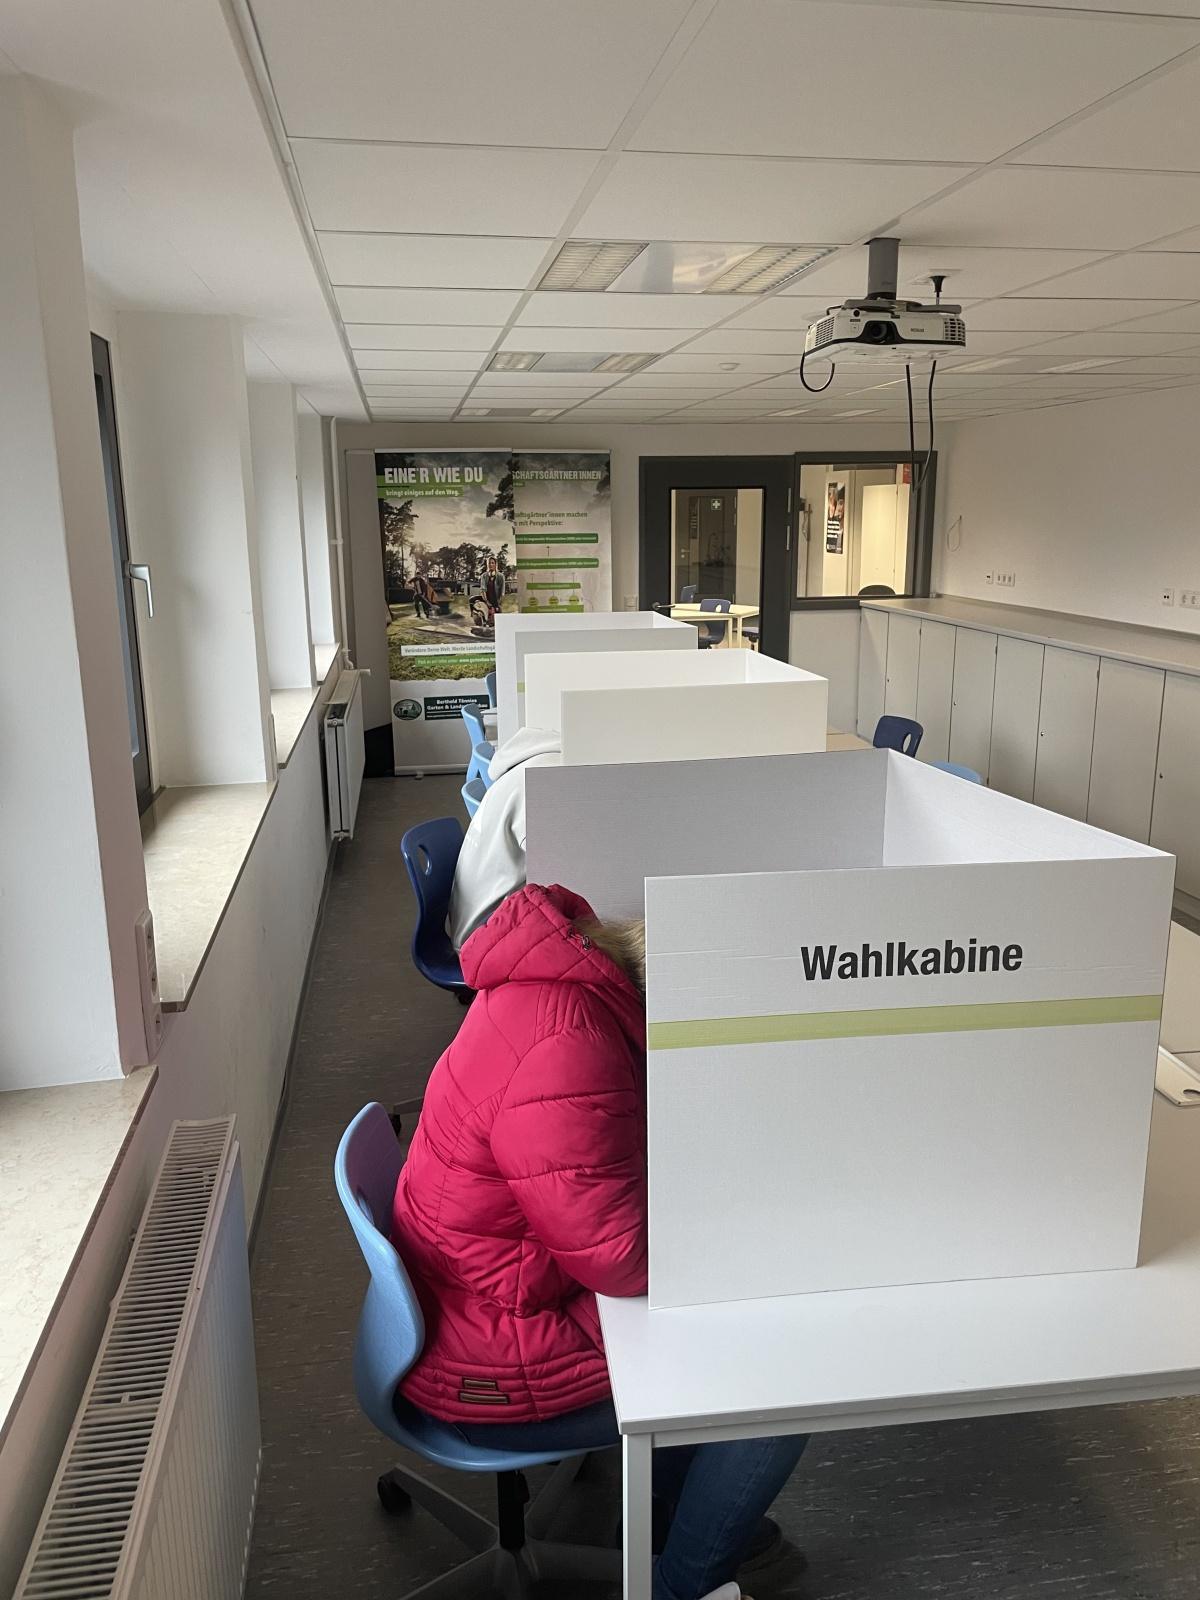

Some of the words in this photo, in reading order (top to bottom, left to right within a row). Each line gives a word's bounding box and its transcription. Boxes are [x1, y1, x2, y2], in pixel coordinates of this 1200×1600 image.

[433, 467, 460, 483] WIE
[464, 466, 483, 483] DU
[386, 489, 404, 498] bringt
[404, 489, 424, 498] einiges
[800, 938, 1023, 981] Wahlkabine
